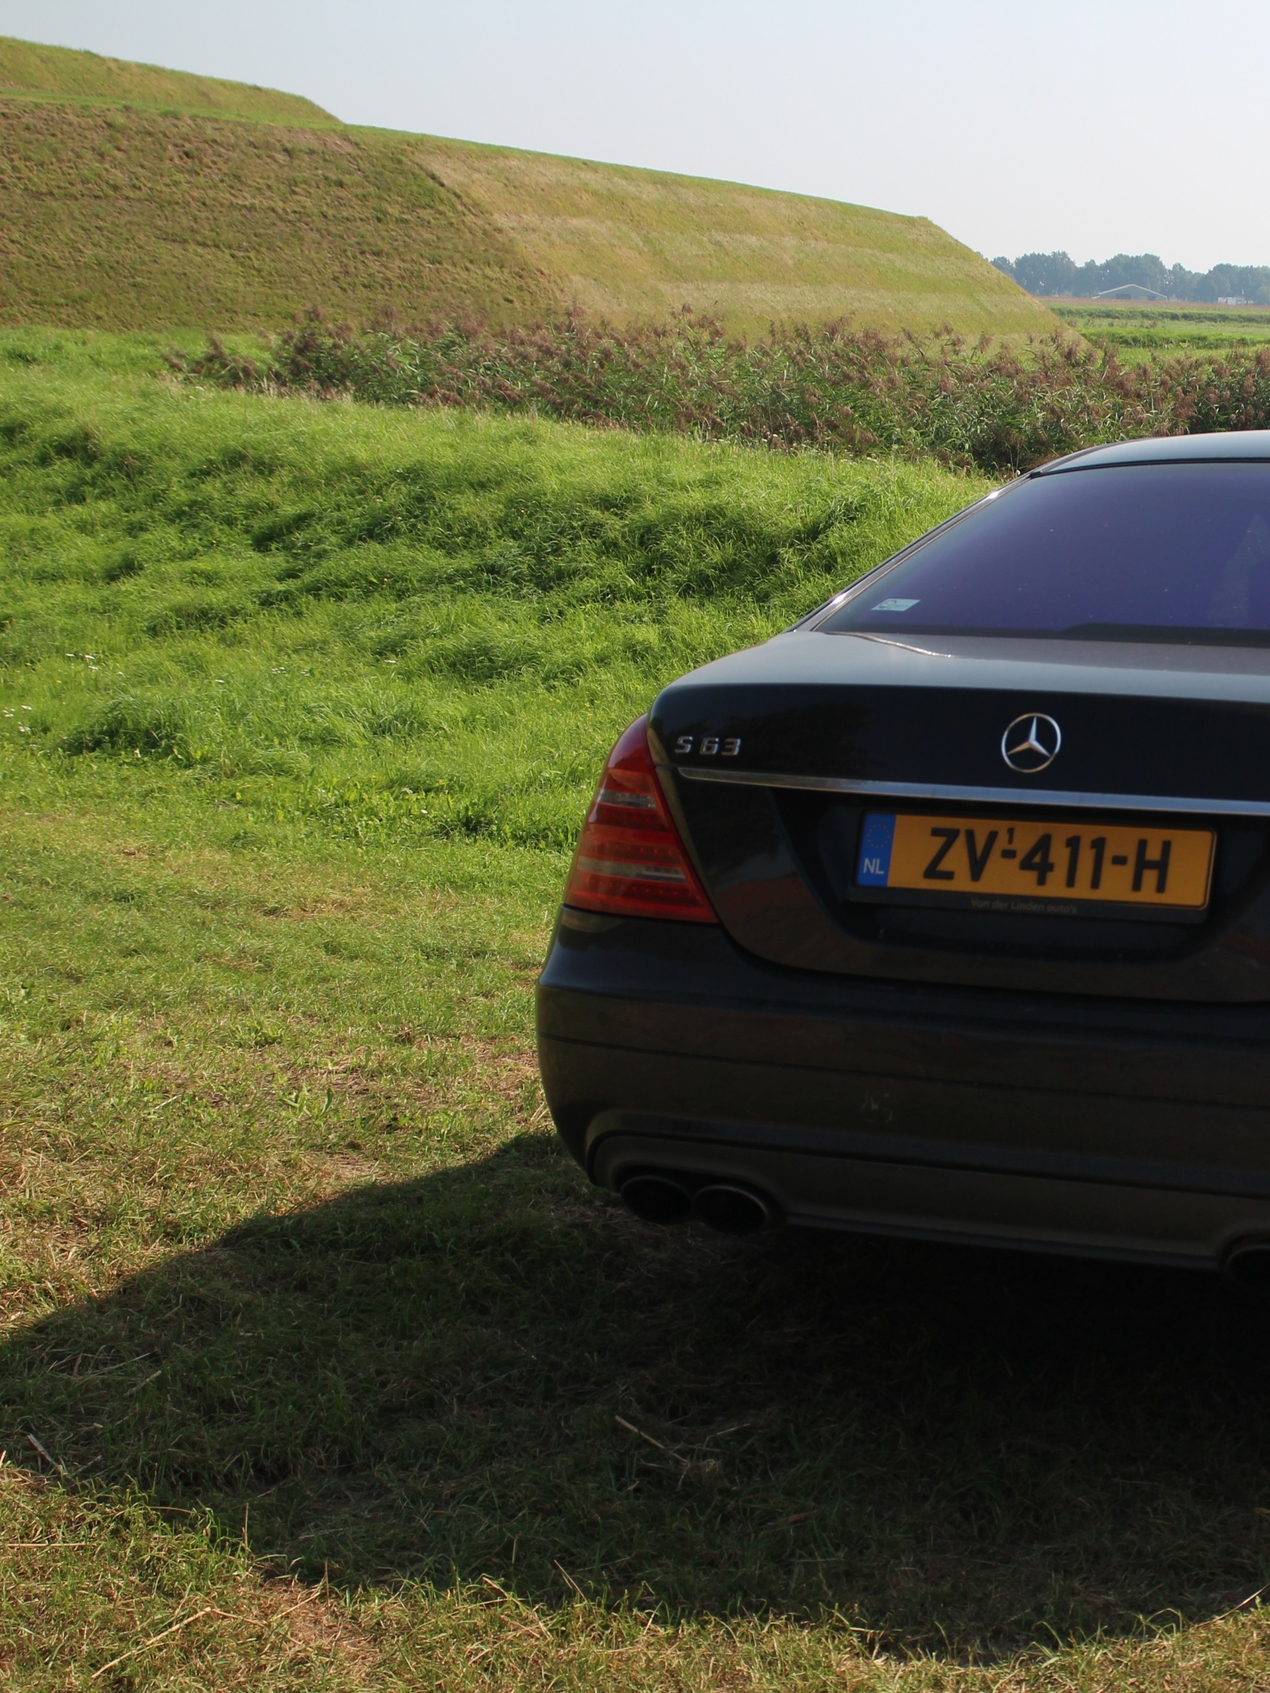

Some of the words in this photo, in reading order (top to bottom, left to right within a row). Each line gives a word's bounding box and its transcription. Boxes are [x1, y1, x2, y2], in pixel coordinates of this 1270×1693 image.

[674, 735, 694, 754] S
[699, 736, 742, 757] 63
[863, 857, 885, 875] NL
[970, 898, 990, 908] Van
[992, 899, 1009, 910] der
[1010, 900, 1045, 911] Linden
